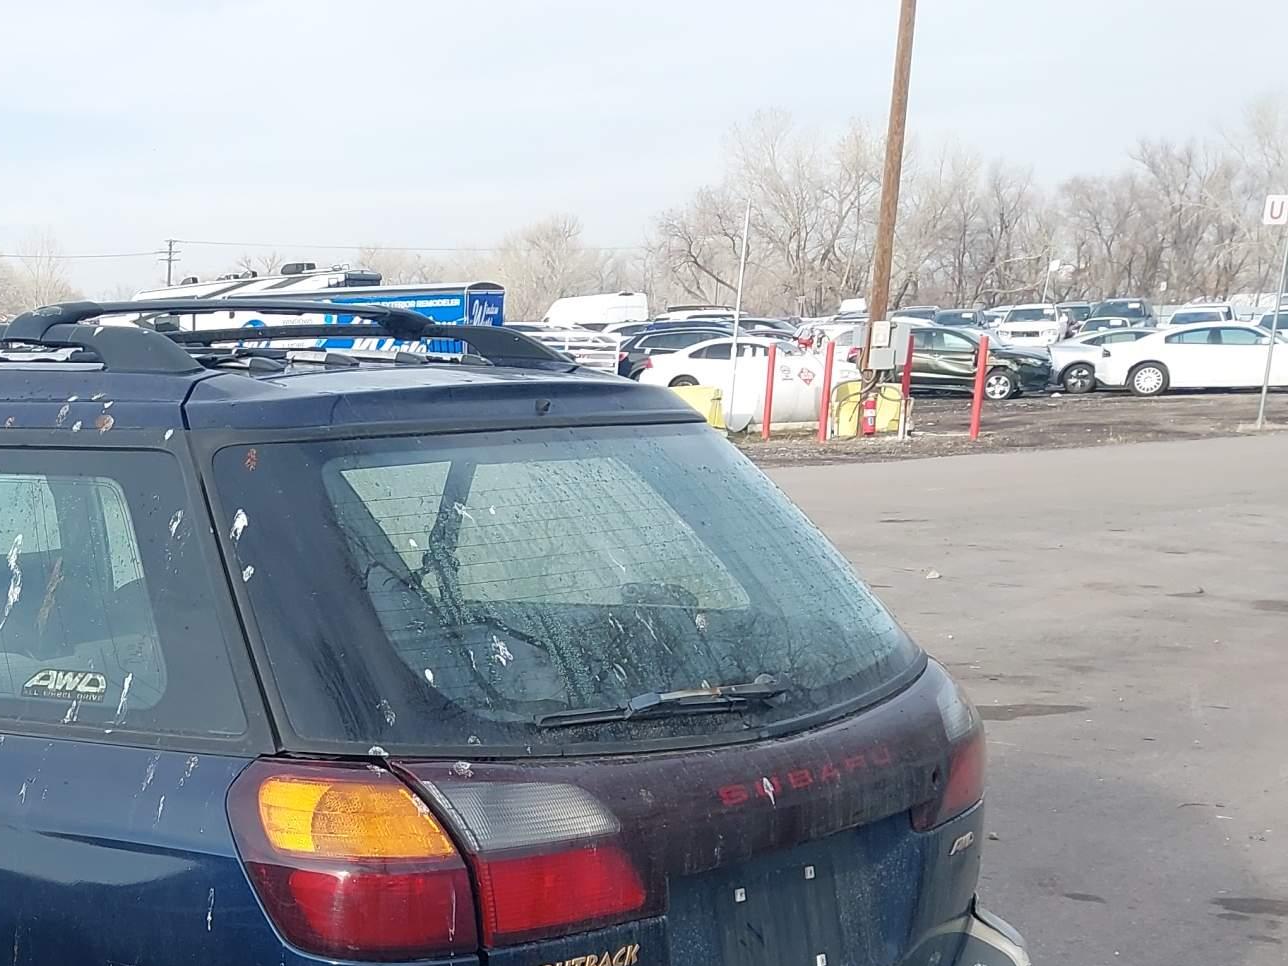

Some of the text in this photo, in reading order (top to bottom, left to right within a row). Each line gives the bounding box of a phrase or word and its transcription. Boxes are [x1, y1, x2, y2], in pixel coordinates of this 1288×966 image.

[1270, 200, 1285, 219] U
[24, 669, 106, 692] AWD
[718, 746, 890, 806] SUBARU
